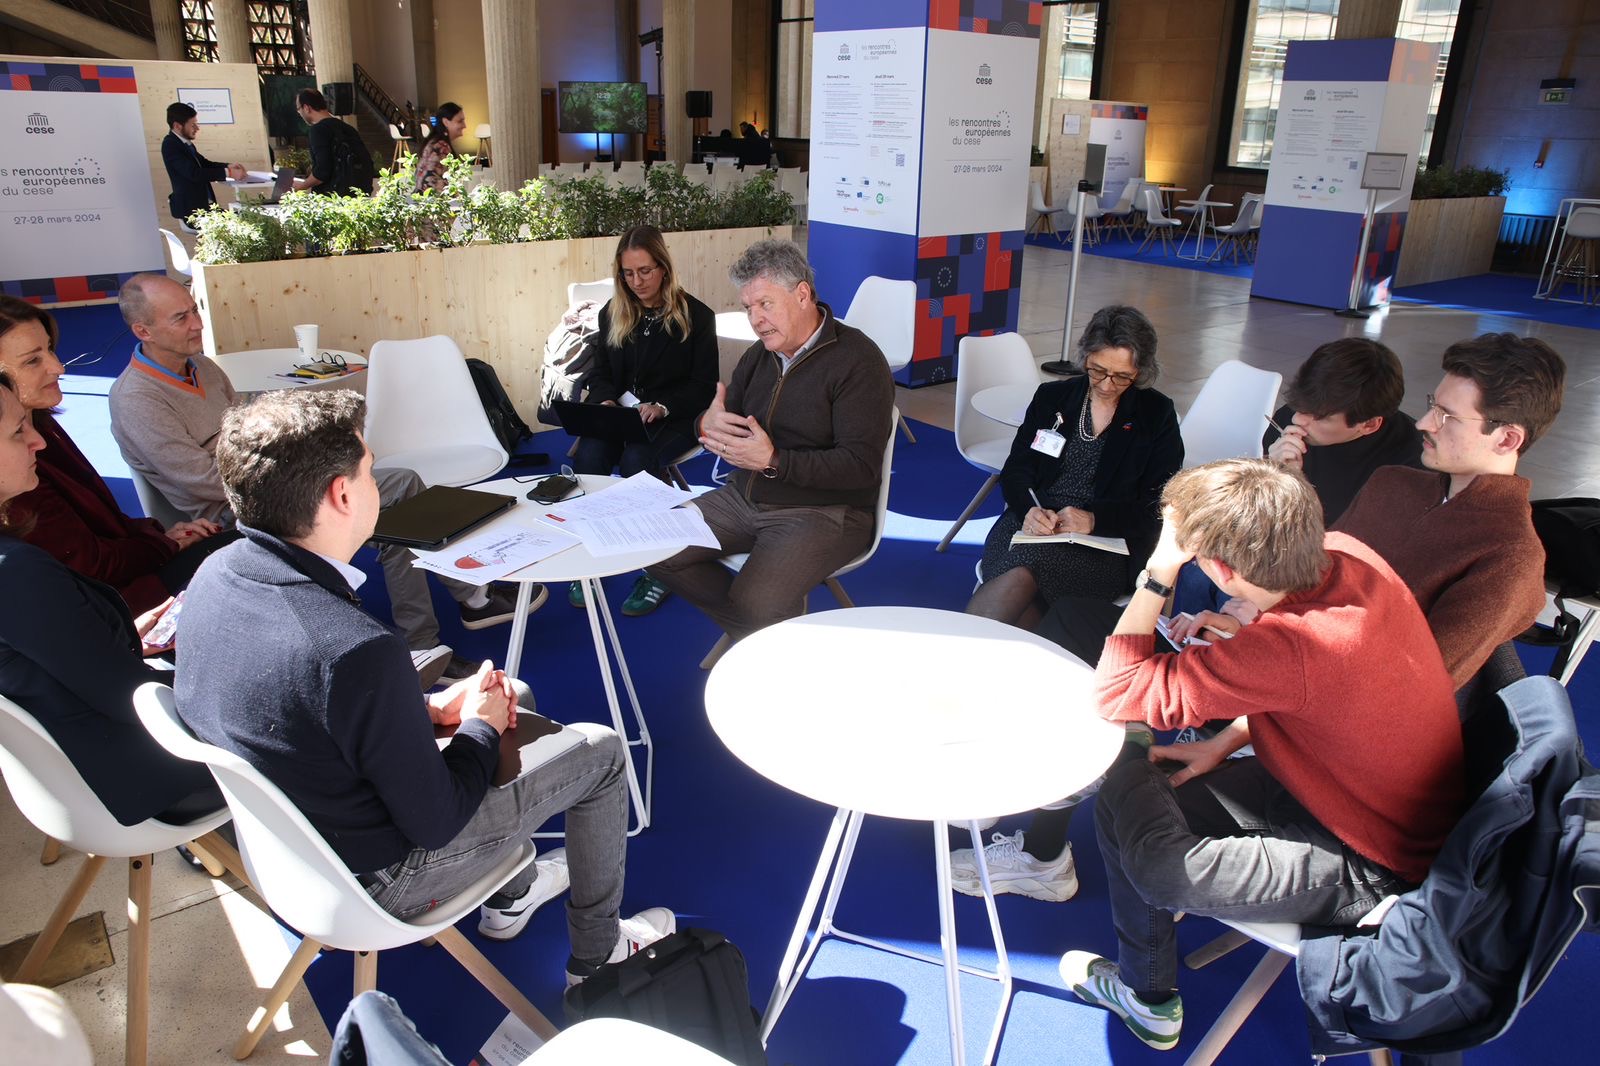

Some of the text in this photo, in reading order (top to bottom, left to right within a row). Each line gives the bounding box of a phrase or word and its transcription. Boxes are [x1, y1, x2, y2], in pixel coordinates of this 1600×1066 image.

[975, 76, 993, 85] cese
[948, 117, 1001, 127] les rencontres
[25, 125, 55, 134] cese
[965, 128, 1011, 138] européennes
[952, 136, 981, 145] du cese
[12, 167, 85, 176] rencontres
[953, 165, 971, 173] 27-28
[987, 164, 1002, 173] 2024
[22, 176, 106, 187] européennes
[2, 186, 54, 196] du cese
[13, 213, 101, 225] 27-28 mars 2024
